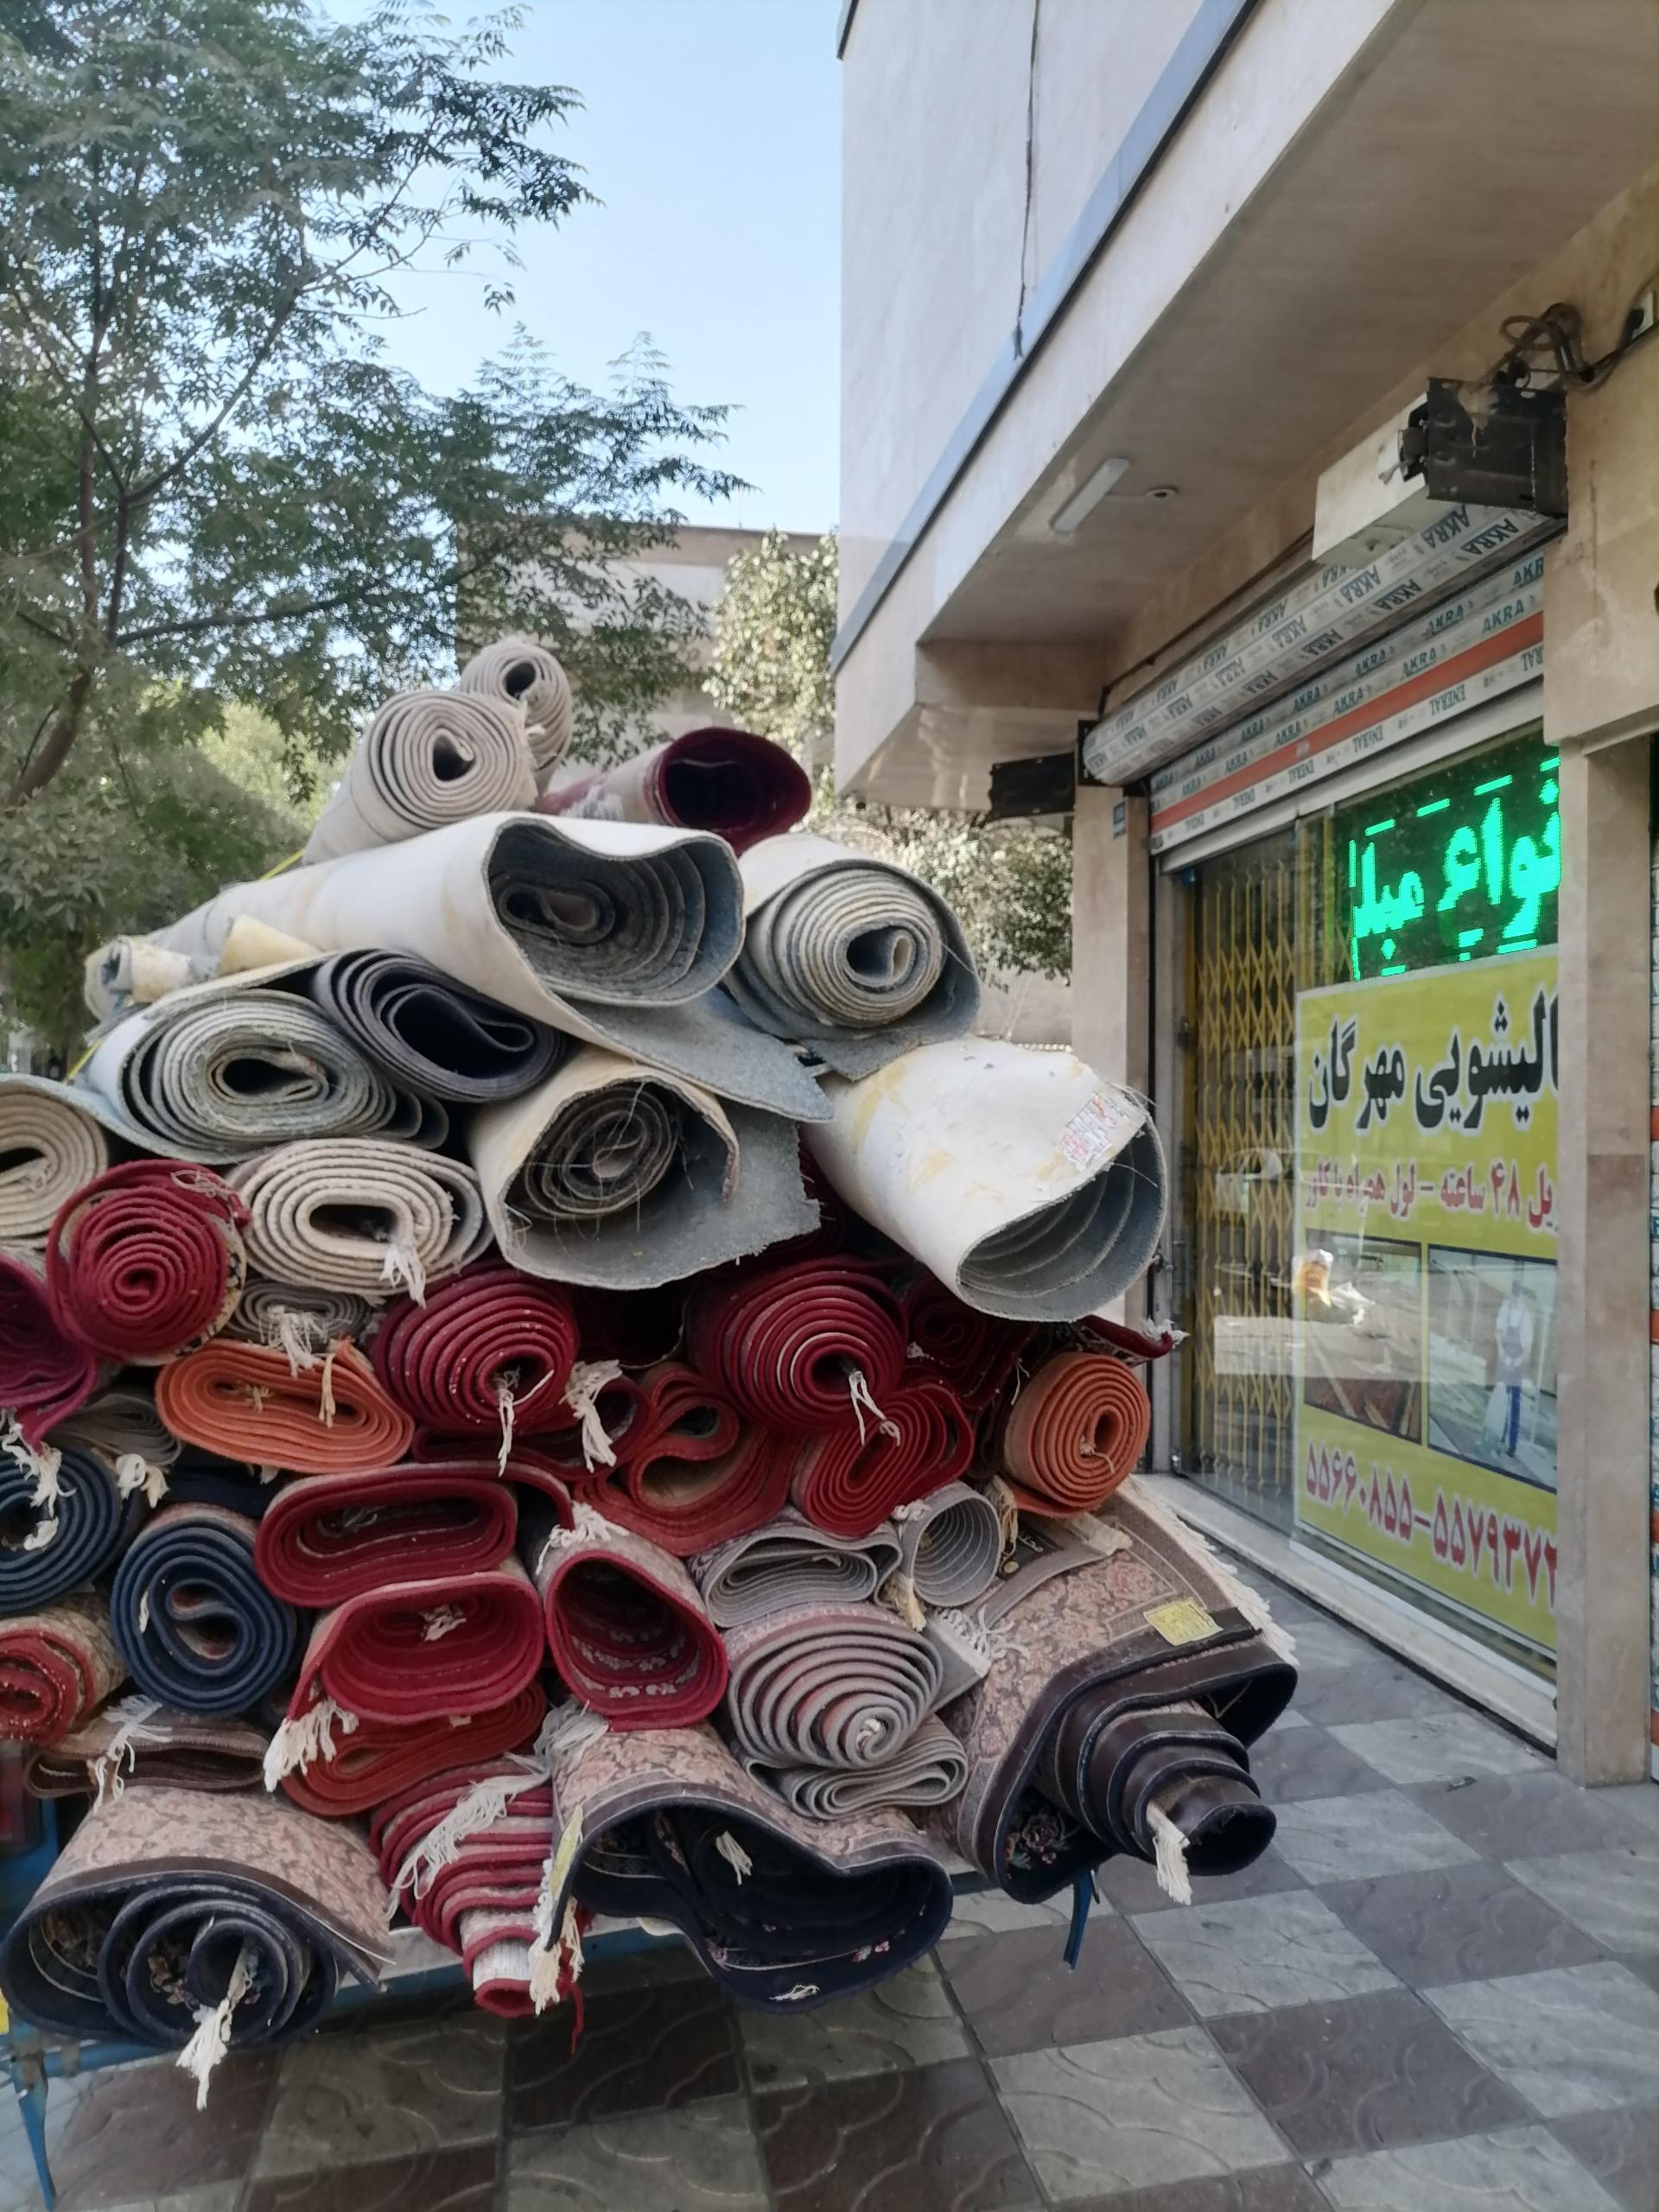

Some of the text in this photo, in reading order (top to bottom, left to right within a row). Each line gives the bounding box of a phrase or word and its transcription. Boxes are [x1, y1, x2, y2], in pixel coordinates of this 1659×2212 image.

[1340, 564, 1382, 603] AKRA
[1421, 504, 1471, 550] AKRA
[1374, 579, 1422, 612] AKRA
[1461, 518, 1520, 556] AKRA
[1274, 719, 1301, 748] AKRA
[1333, 686, 1364, 716] AKRA
[1402, 647, 1437, 679] AKRA
[1482, 600, 1524, 633] AKRA
[1354, 648, 1386, 677] AKRA
[1427, 605, 1465, 636] AKRA
[1310, 1020, 1405, 1128] مهرگان
[1491, 1162, 1521, 1217] ۴۸
